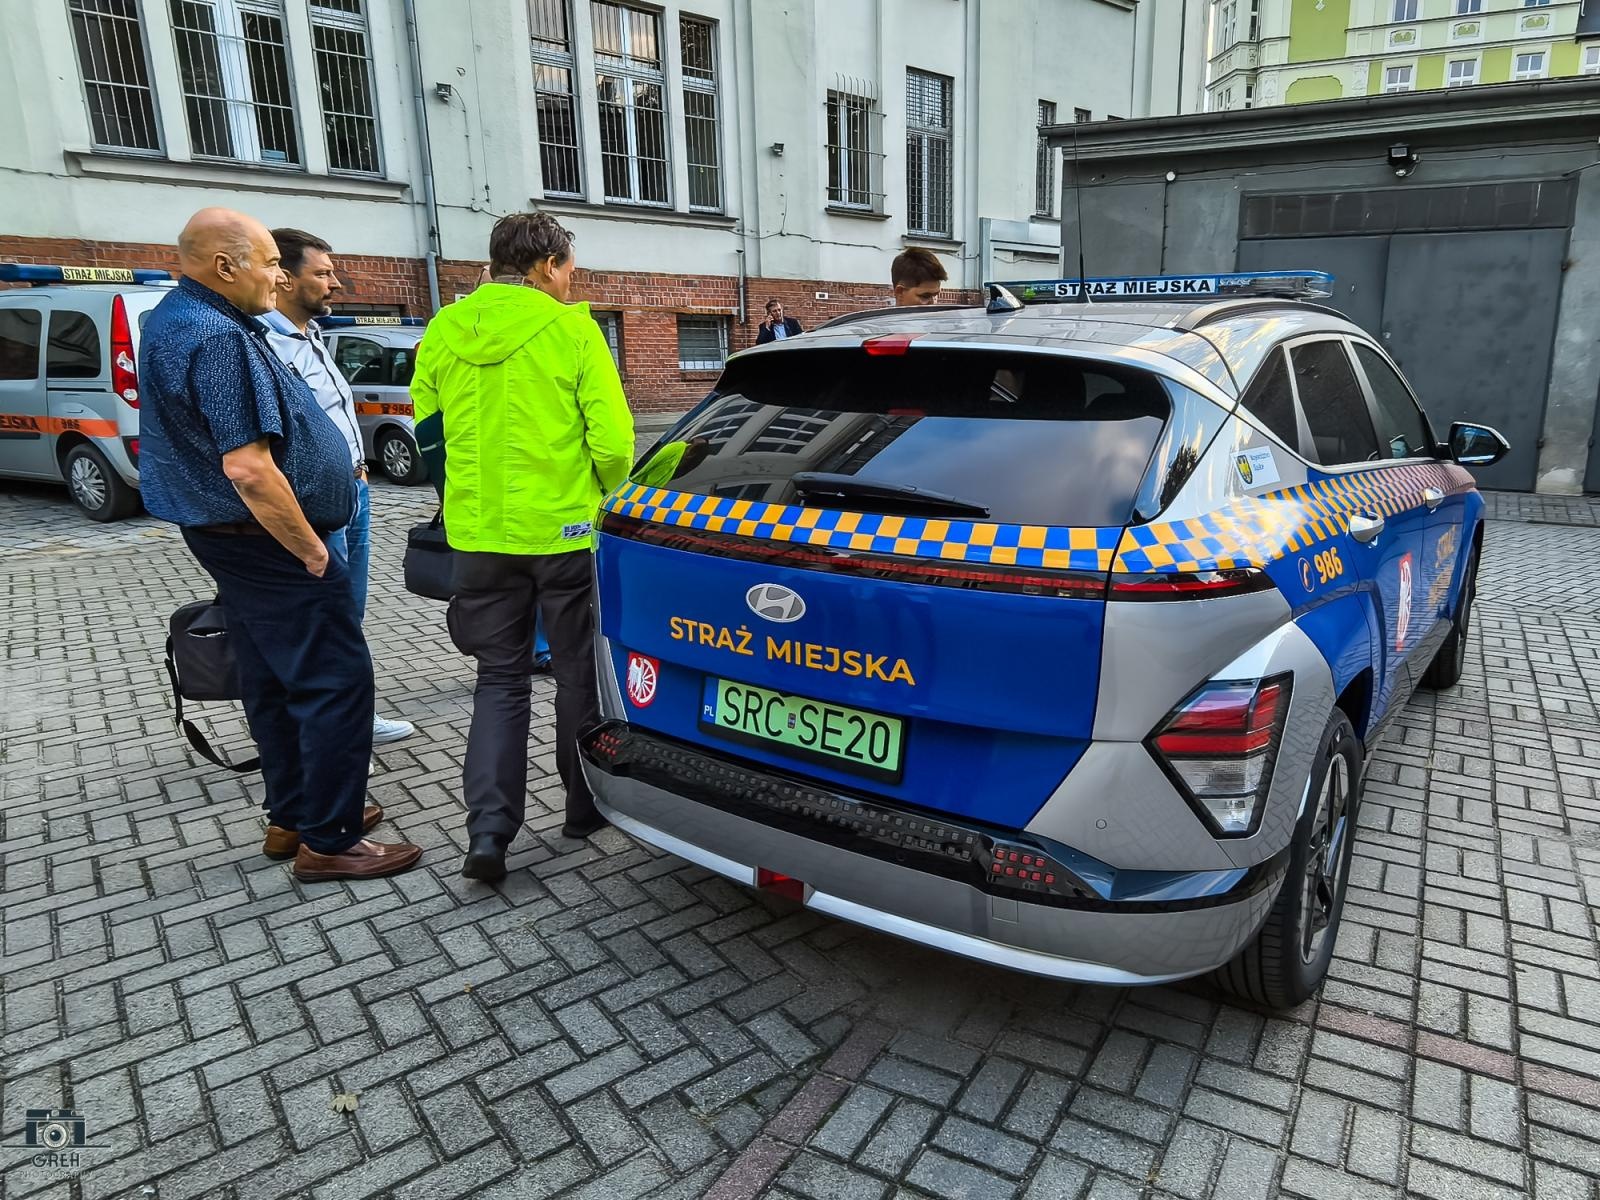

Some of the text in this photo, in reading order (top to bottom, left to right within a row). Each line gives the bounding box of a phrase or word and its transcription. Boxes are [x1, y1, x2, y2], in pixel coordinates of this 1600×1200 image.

[95, 270, 132, 282] MIEJSKA
[1123, 280, 1211, 294] MIEJSKA
[391, 404, 411, 415] 986
[1314, 547, 1343, 584] 986
[669, 616, 916, 686] STRAŻ MIEJSKA
[703, 704, 714, 718] PL
[722, 686, 890, 764] SRC SE20
